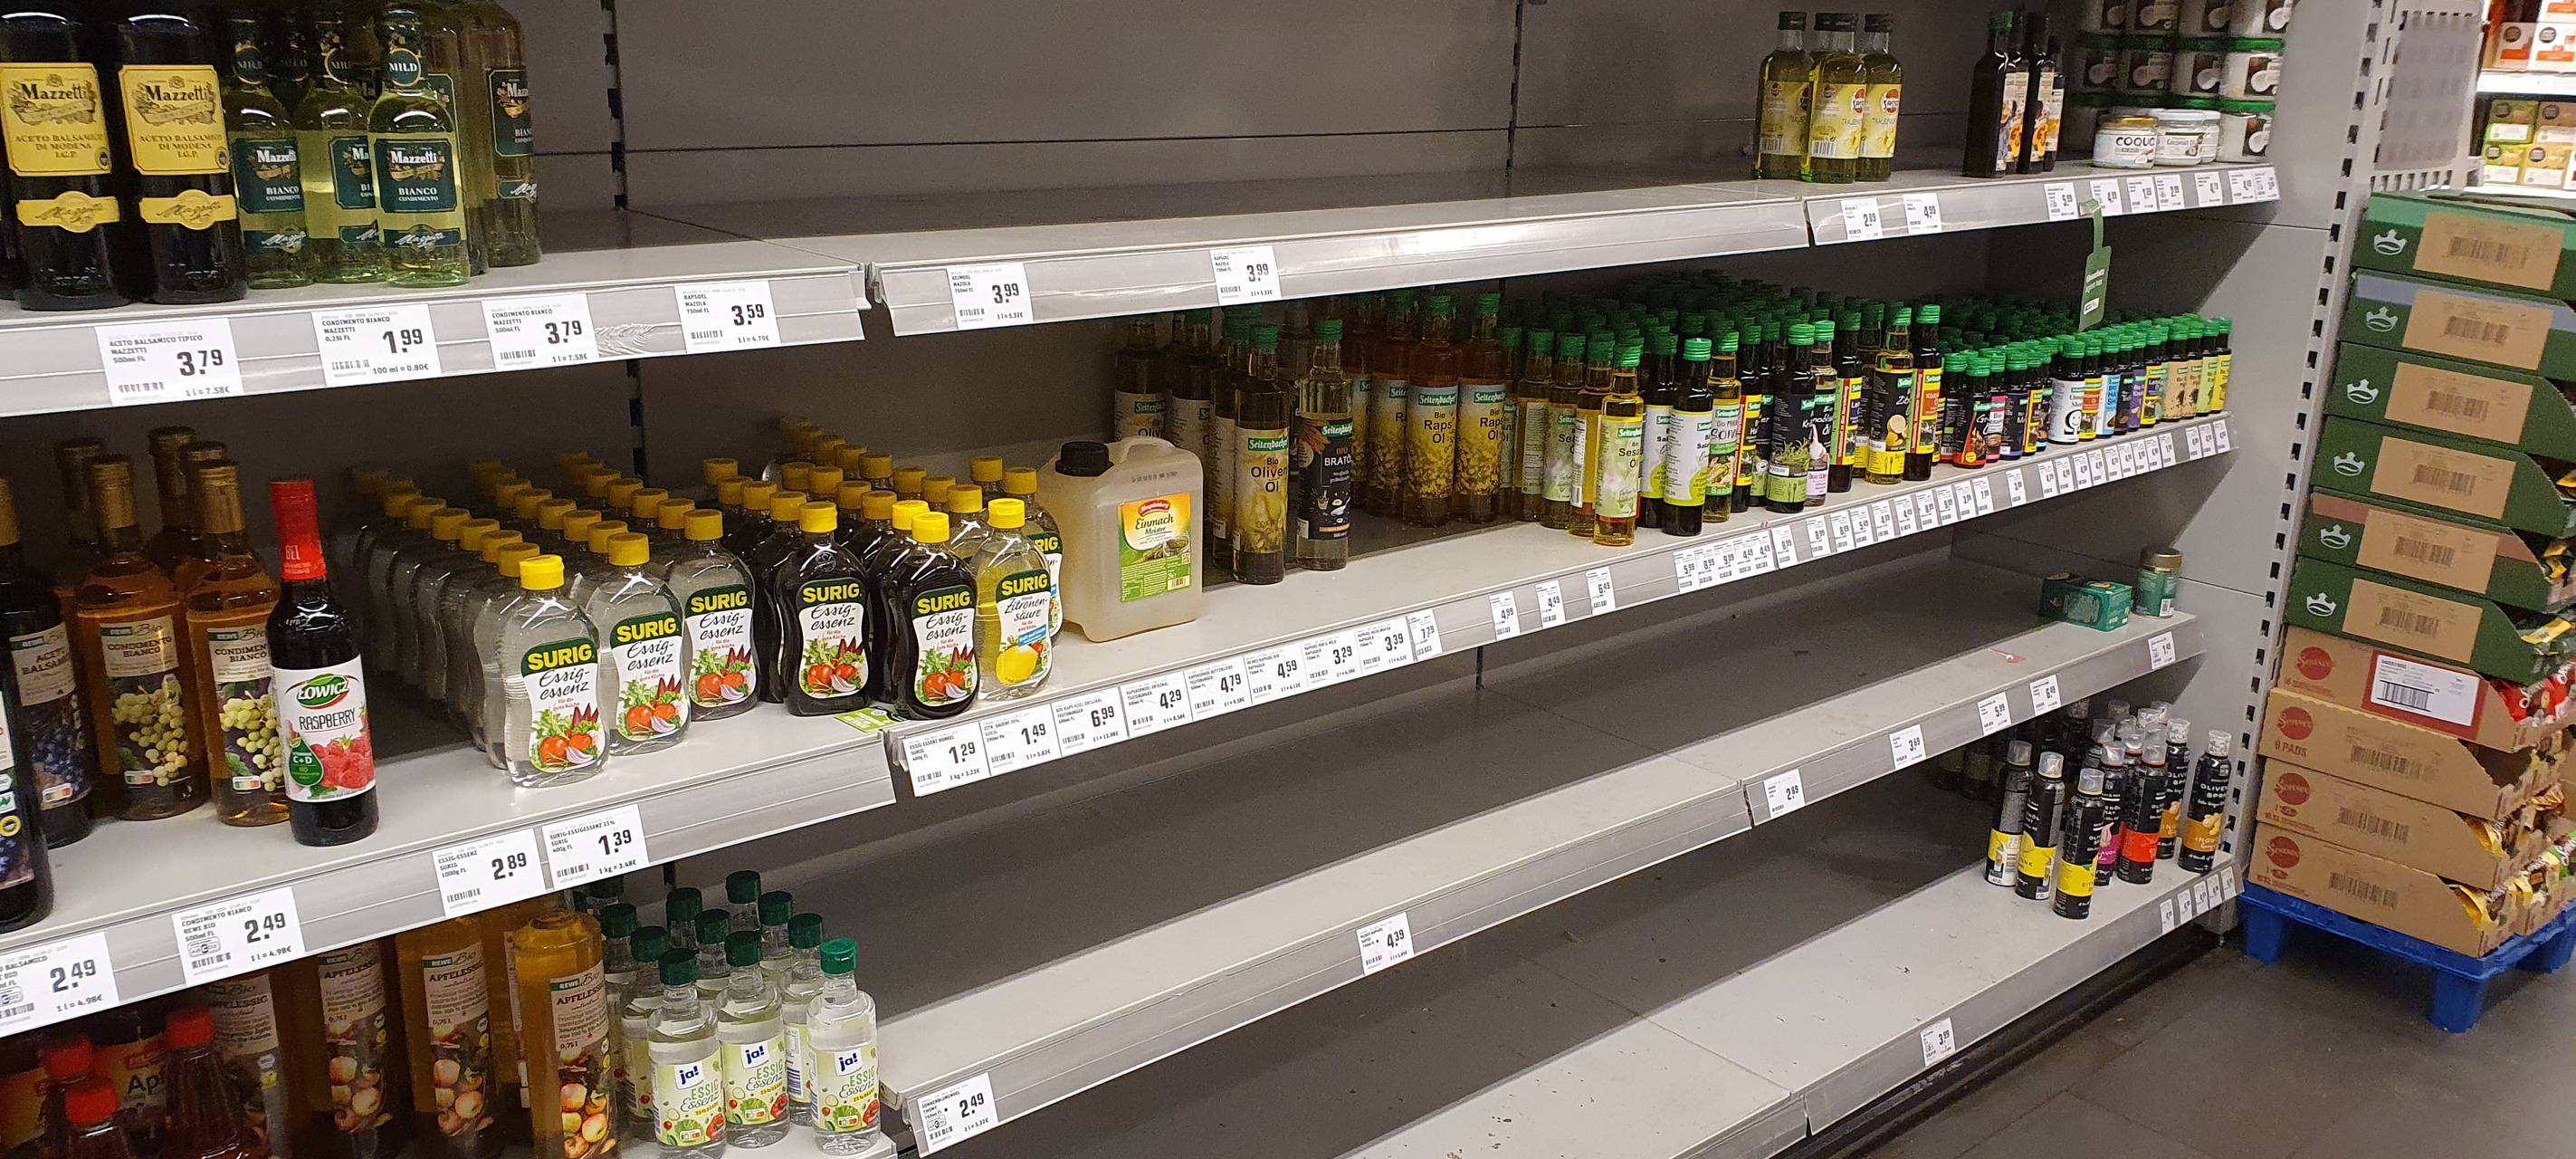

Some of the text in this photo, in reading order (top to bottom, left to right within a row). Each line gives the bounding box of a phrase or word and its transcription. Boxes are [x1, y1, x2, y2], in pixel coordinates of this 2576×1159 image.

[388, 61, 418, 73] MILD
[21, 80, 88, 101] Mazzetti
[146, 82, 210, 101] Mazzetti
[390, 149, 438, 165] Mazzetti
[266, 186, 301, 196] BIANCO
[397, 187, 438, 196] BIANCO
[1246, 263, 1269, 283] 3.99
[991, 283, 1020, 304] 3.99
[322, 316, 391, 327] CONDIMENTO BIANCO
[491, 310, 530, 319] CONDIMENTO
[731, 303, 765, 326] 3.59
[110, 340, 133, 348] ACETO
[134, 336, 177, 346] BALSAMICO
[382, 329, 424, 354] 1.99
[545, 320, 582, 345] 3.79
[110, 348, 148, 356] MAZZETTI
[177, 349, 224, 377] 3.79
[406, 363, 429, 372] 0.80€
[1423, 419, 1453, 431] Raps
[1479, 417, 1503, 428] Raps
[1266, 456, 1279, 465] Bio
[1250, 465, 1288, 477] Oliven
[1265, 480, 1279, 493] Öl
[1134, 513, 1174, 531] Einmach
[1036, 536, 1059, 552] RIG
[802, 583, 860, 604] SURIG
[1000, 573, 1048, 596] SURIG
[691, 590, 748, 613] SURIG
[811, 603, 856, 619] Essig-
[917, 590, 971, 614] SURIG
[1004, 596, 1048, 615] Zitronen-
[700, 611, 746, 629] Essig-
[811, 616, 855, 631] essenz
[926, 612, 968, 630] Essig-
[1013, 607, 1042, 622] säure
[616, 618, 677, 643] SURIG
[700, 624, 744, 641] essenz
[926, 625, 968, 642] essenz
[123, 646, 162, 658] BIANCO
[214, 643, 267, 656] CONDIMEN
[627, 639, 674, 659] Essig-
[1384, 633, 1404, 652] 3.39
[229, 651, 267, 663] BIANCO
[527, 644, 593, 672] SURIG
[627, 652, 674, 672] essenz
[1332, 646, 1352, 666] 3.29
[539, 668, 590, 688] Essig-
[1277, 659, 1298, 679] 4.59
[297, 680, 350, 702] ŁOWICZ
[539, 681, 590, 701] essenz
[1220, 673, 1242, 694] 4.79
[1159, 689, 1182, 710] 4.29
[299, 708, 357, 732] RASPBERRY
[1091, 705, 1115, 728] 6.99
[1020, 723, 1046, 746] 1.49
[948, 741, 977, 765] 1.29
[2282, 742, 2307, 758] PADS
[550, 838, 569, 848] SURIG
[597, 829, 633, 856] 1.39
[440, 862, 458, 871] SURIG
[491, 852, 528, 881] 2.89
[604, 858, 637, 874] kg 3.48€
[181, 905, 253, 927] CONDIMENTO BIANCO
[244, 913, 287, 944] 2.49
[1387, 929, 1405, 949] 4.39
[50, 959, 97, 993] 2.49
[744, 1045, 765, 1065] ja!
[838, 1052, 859, 1073] ja!
[679, 1064, 701, 1086] ja!
[756, 1058, 784, 1080] ESSIG
[849, 1065, 875, 1087] ESSIG
[691, 1078, 720, 1101] ESSIG
[746, 1070, 783, 1092] Essenz
[959, 1092, 985, 1119] 2.49
